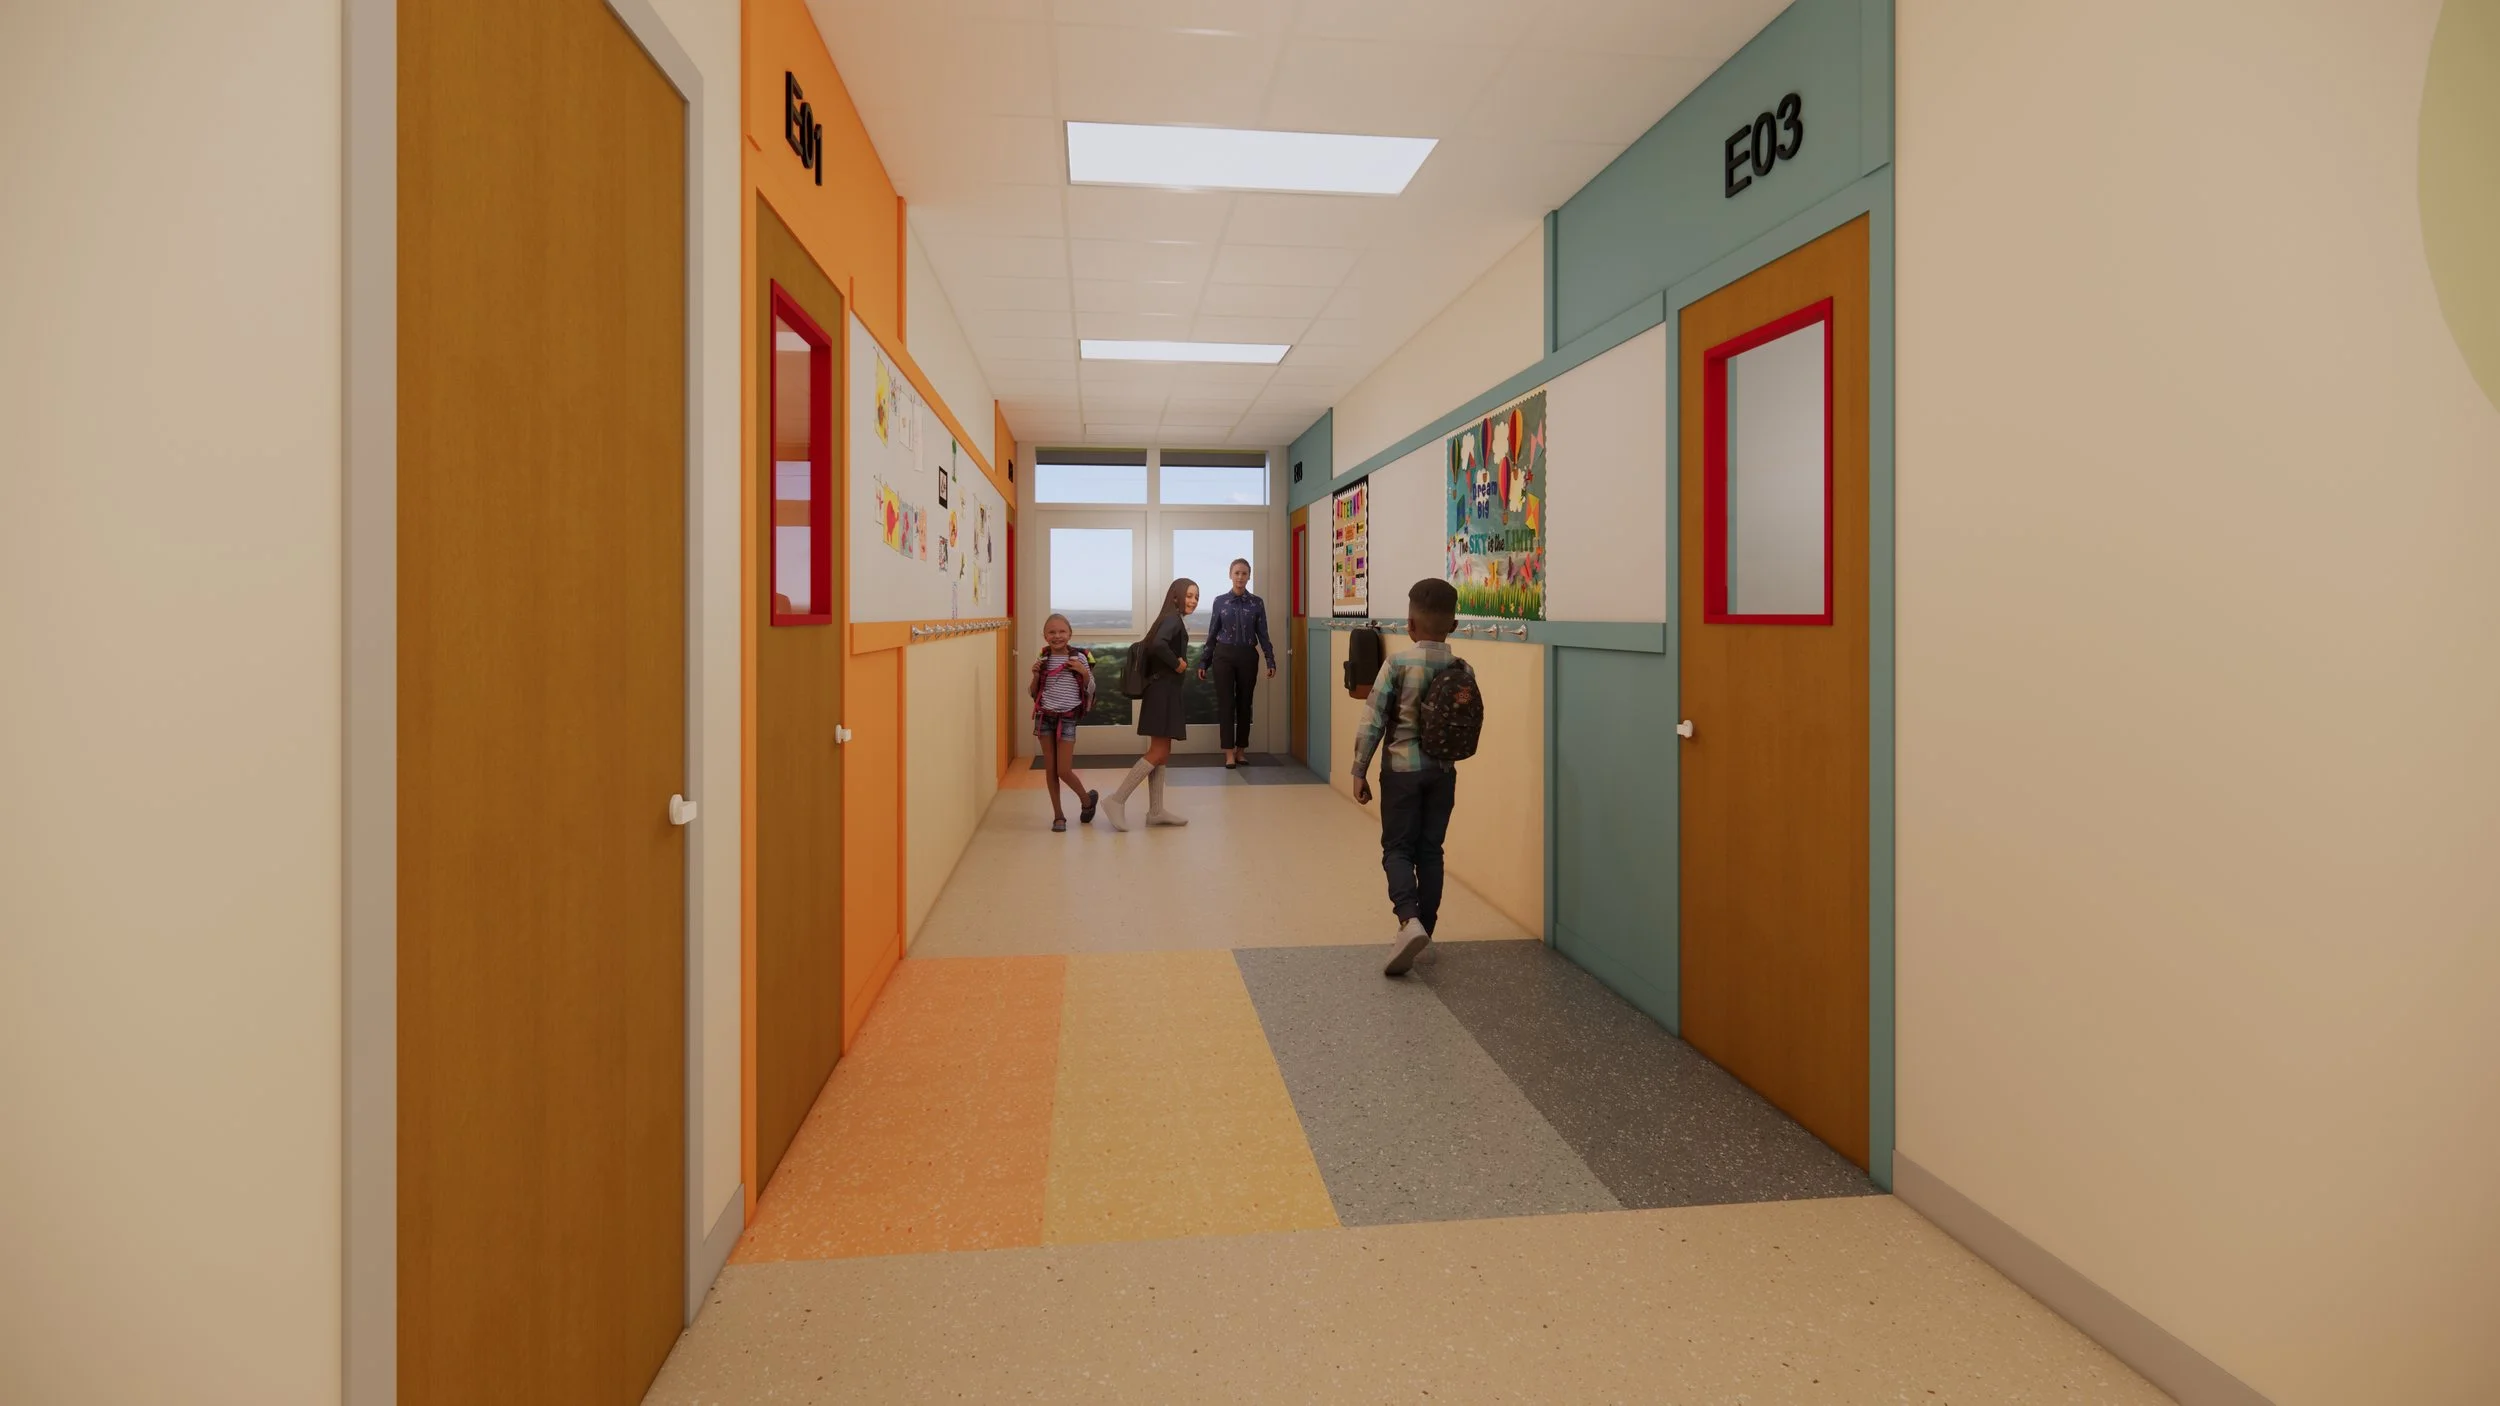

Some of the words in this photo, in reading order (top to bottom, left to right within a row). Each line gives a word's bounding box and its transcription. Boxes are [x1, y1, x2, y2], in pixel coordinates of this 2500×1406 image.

[785, 71, 822, 187] E01
[1725, 92, 1804, 199] E03
[1458, 537, 1469, 557] The
[1469, 533, 1487, 555] SKY
[1487, 535, 1494, 553] is
[1494, 533, 1505, 552] the
[1505, 529, 1535, 553] LIMIT
